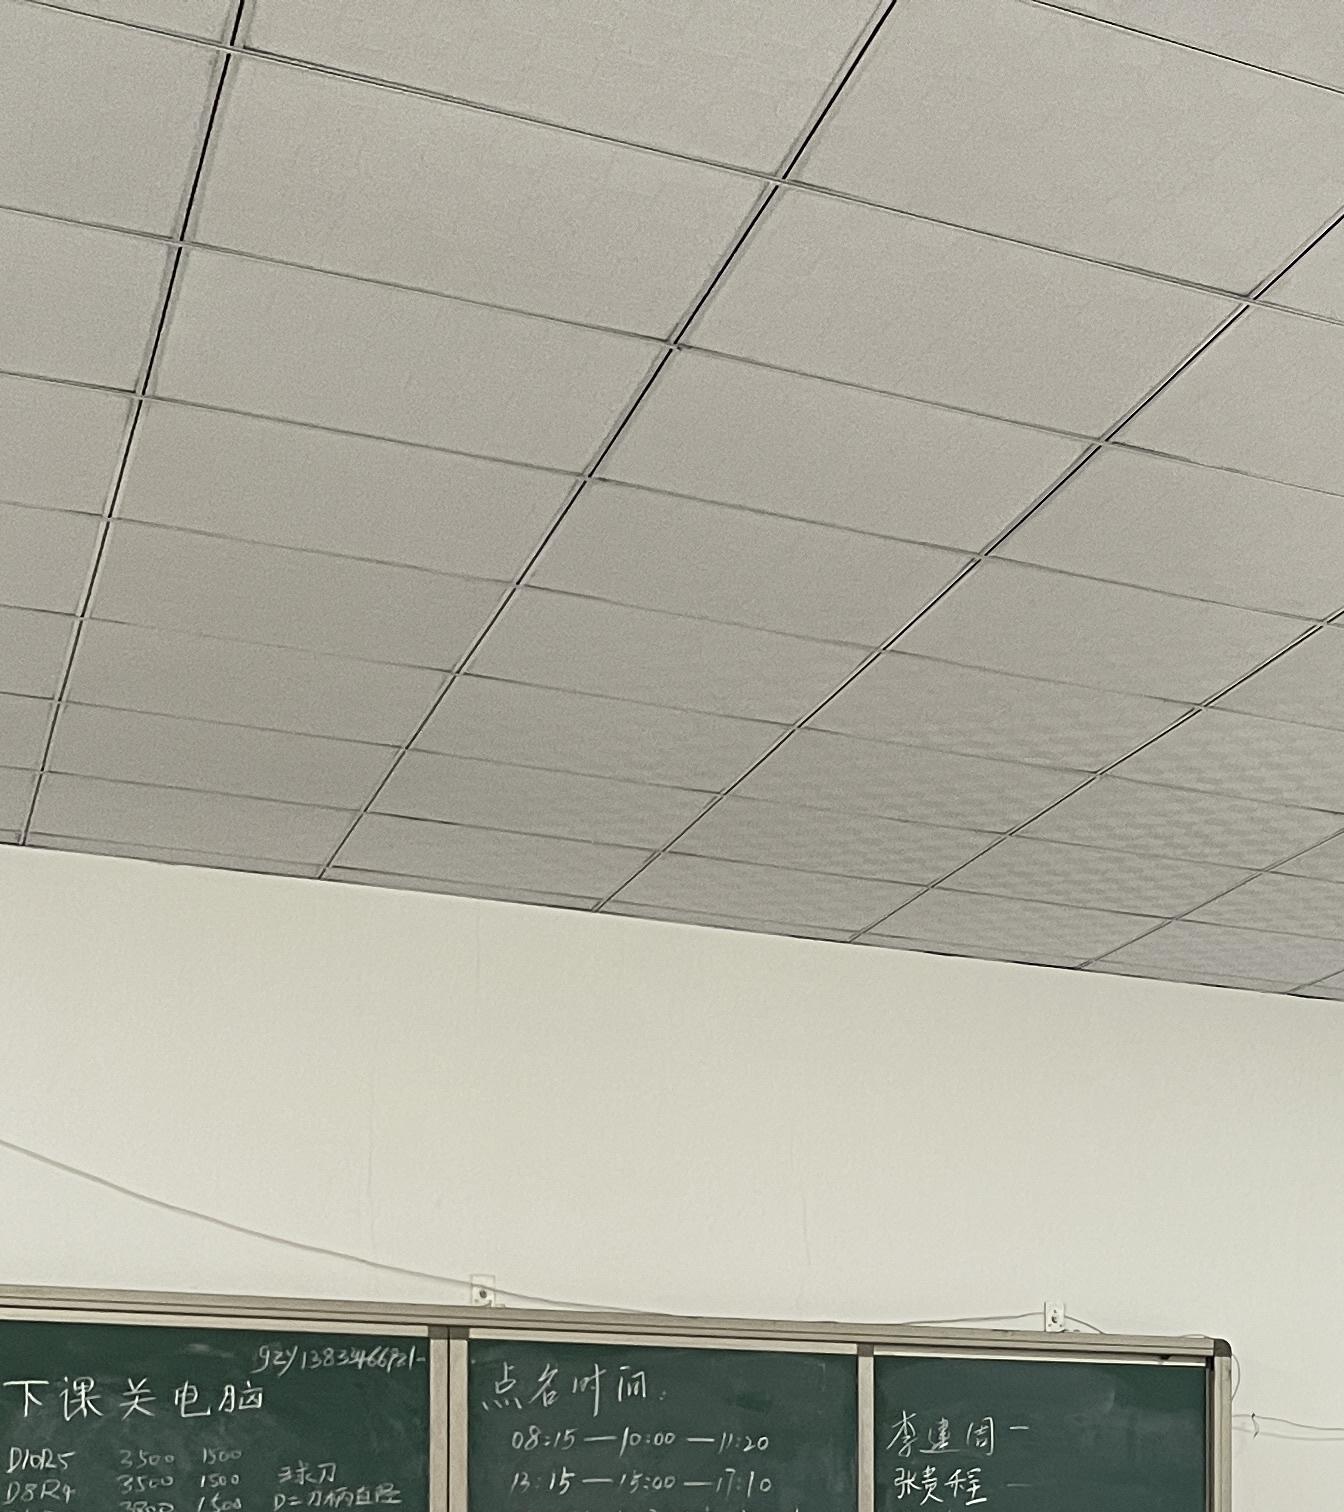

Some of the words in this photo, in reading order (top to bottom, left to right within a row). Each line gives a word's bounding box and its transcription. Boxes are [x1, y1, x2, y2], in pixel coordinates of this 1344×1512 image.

[3, 1376, 264, 1422] 下课关电脑
